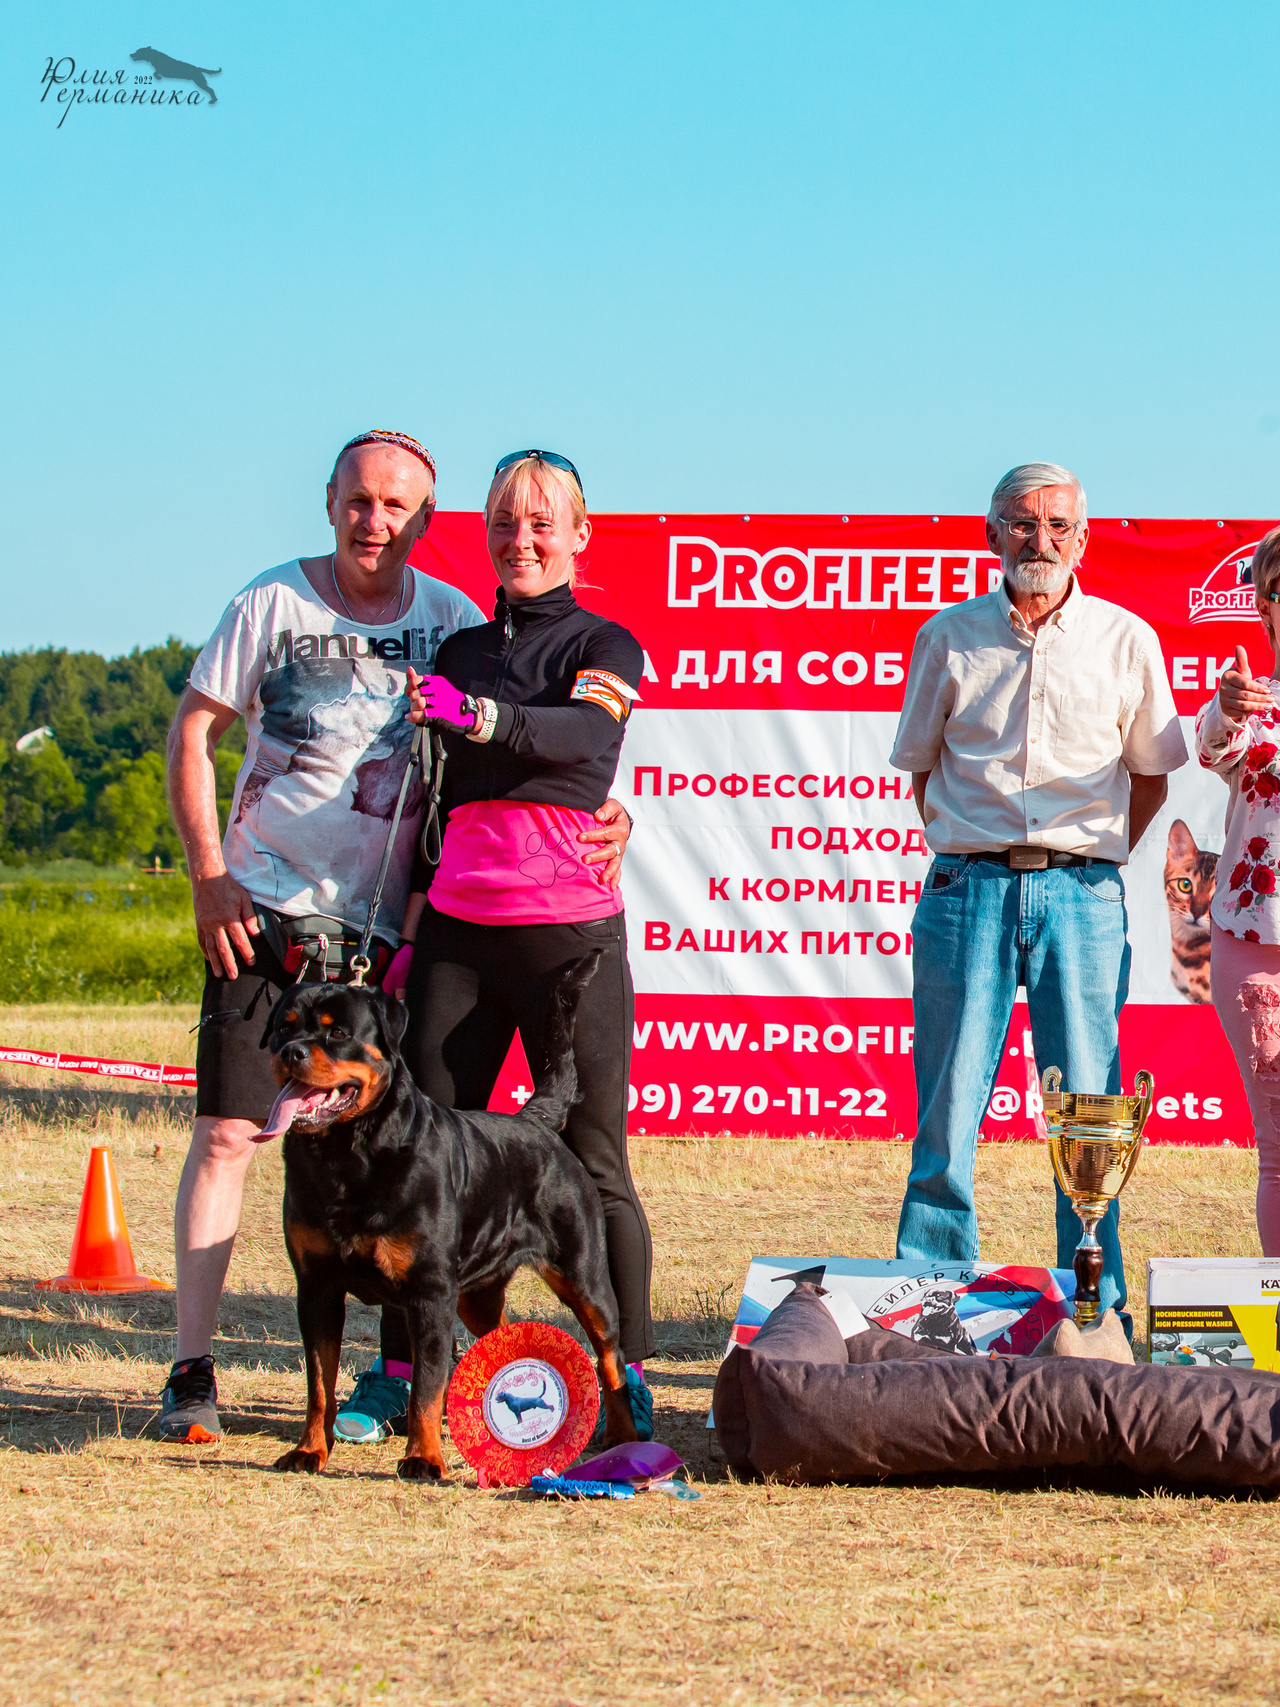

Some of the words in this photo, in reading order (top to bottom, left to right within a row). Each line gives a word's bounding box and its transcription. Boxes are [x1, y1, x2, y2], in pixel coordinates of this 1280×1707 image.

[671, 650, 782, 689] ДЛЯ
[771, 827, 928, 856] ПОДХОД
[709, 877, 730, 901] К
[644, 921, 789, 953] ВАШИХ
[99, 1063, 161, 1081] ТРАПЕЗА
[692, 1084, 888, 1117] 270-11-22
